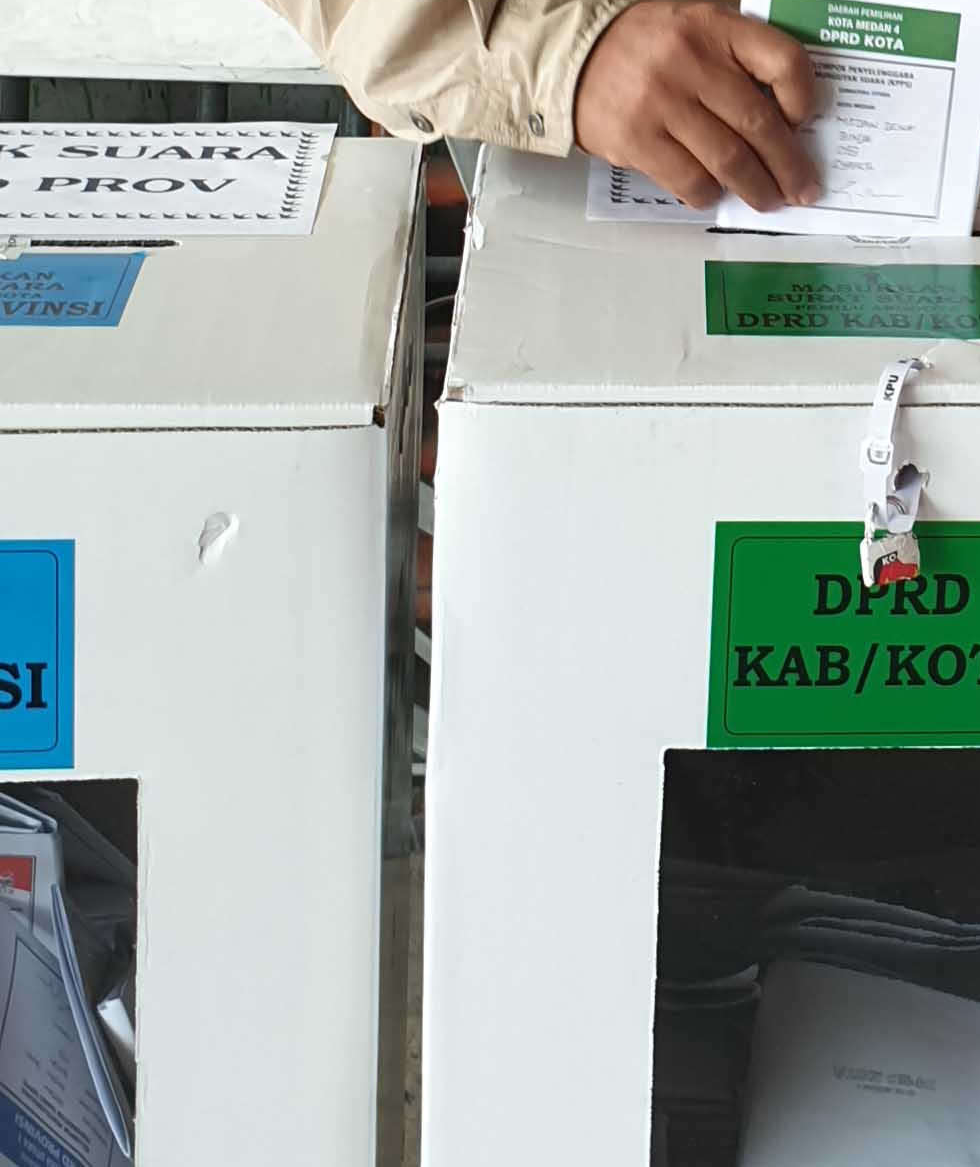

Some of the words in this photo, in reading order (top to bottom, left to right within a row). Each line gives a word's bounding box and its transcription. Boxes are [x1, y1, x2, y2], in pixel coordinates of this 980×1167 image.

[828, 4, 860, 16] DAERAH
[828, 15, 854, 29] KOTA
[855, 19, 891, 35] MEDAN
[893, 24, 901, 35] 4
[820, 28, 861, 46] DPRD
[863, 35, 905, 52] KOTA
[57, 145, 288, 160] SUARA
[34, 176, 236, 193] PROV
[766, 293, 867, 304] SURAT
[736, 313, 833, 330] DPRD
[883, 373, 900, 402] KPU
[812, 572, 971, 616] DPRD
